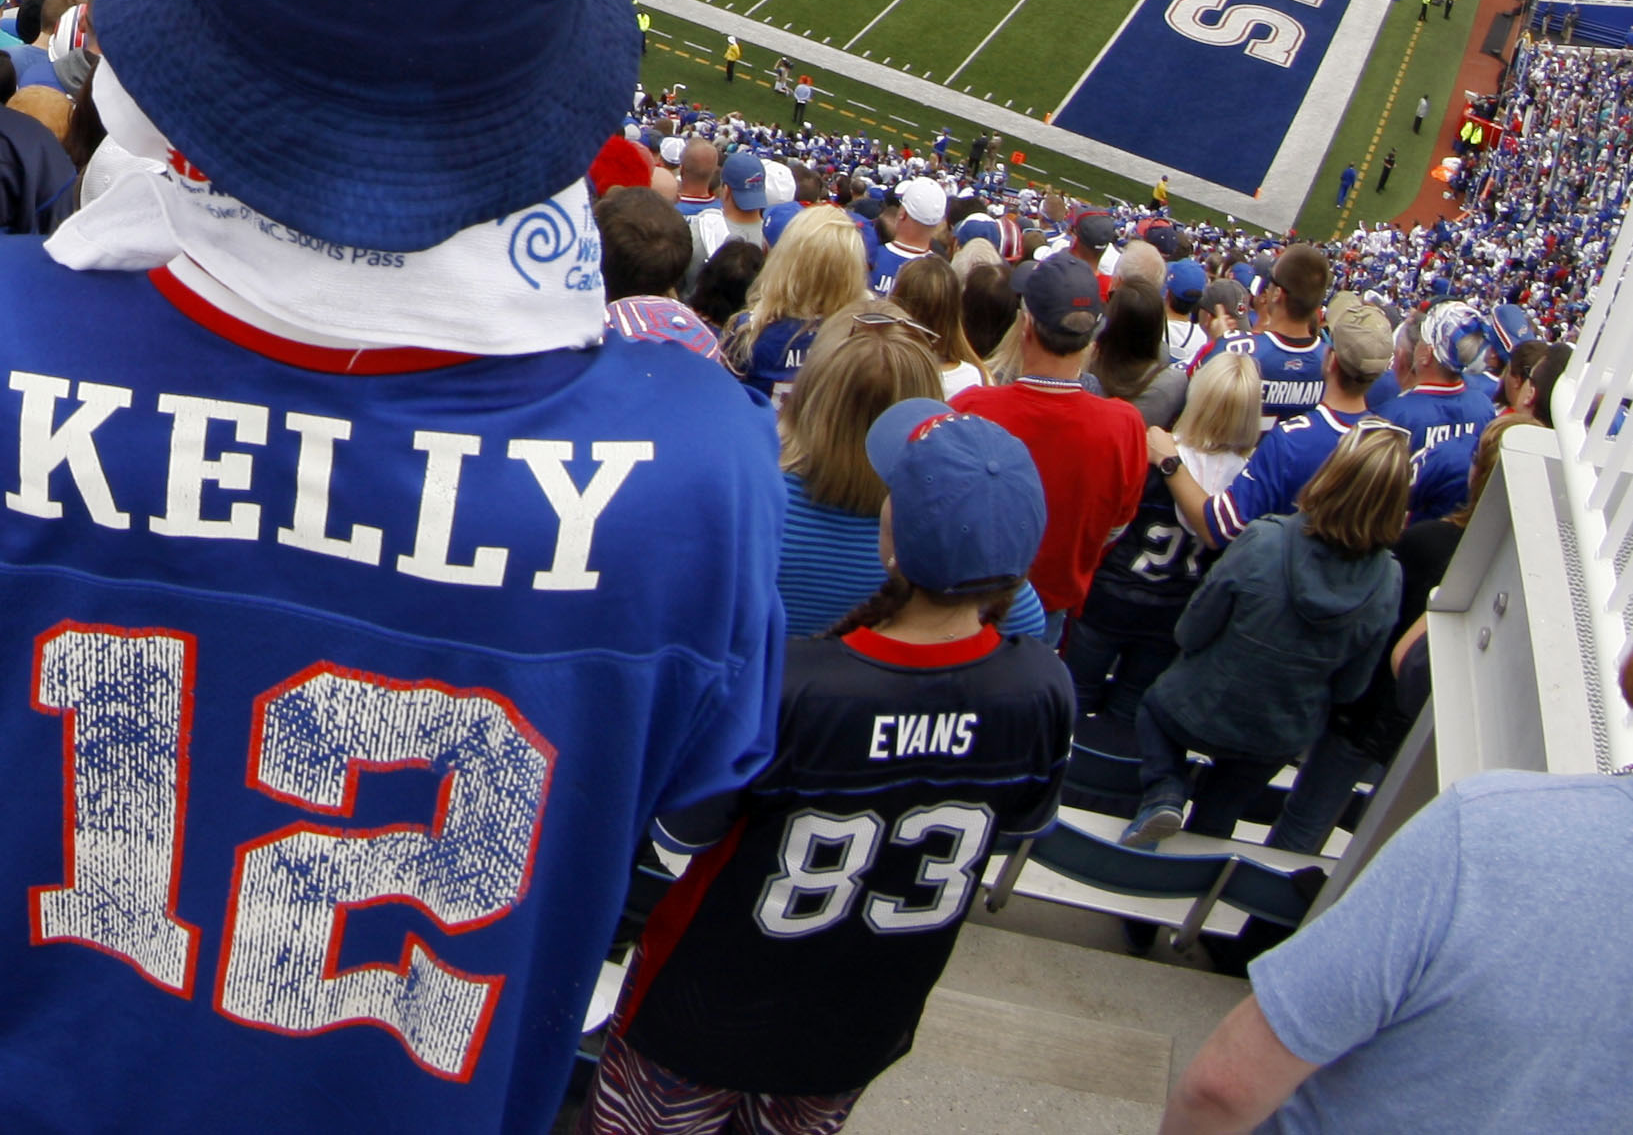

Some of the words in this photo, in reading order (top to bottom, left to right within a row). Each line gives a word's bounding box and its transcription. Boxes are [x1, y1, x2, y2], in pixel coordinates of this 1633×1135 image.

[287, 227, 344, 261] Sports
[352, 246, 405, 269] Pass
[6, 370, 654, 591] KELLY
[869, 713, 978, 760] EVANS
[29, 620, 558, 1083] 12
[753, 800, 995, 939] 83
